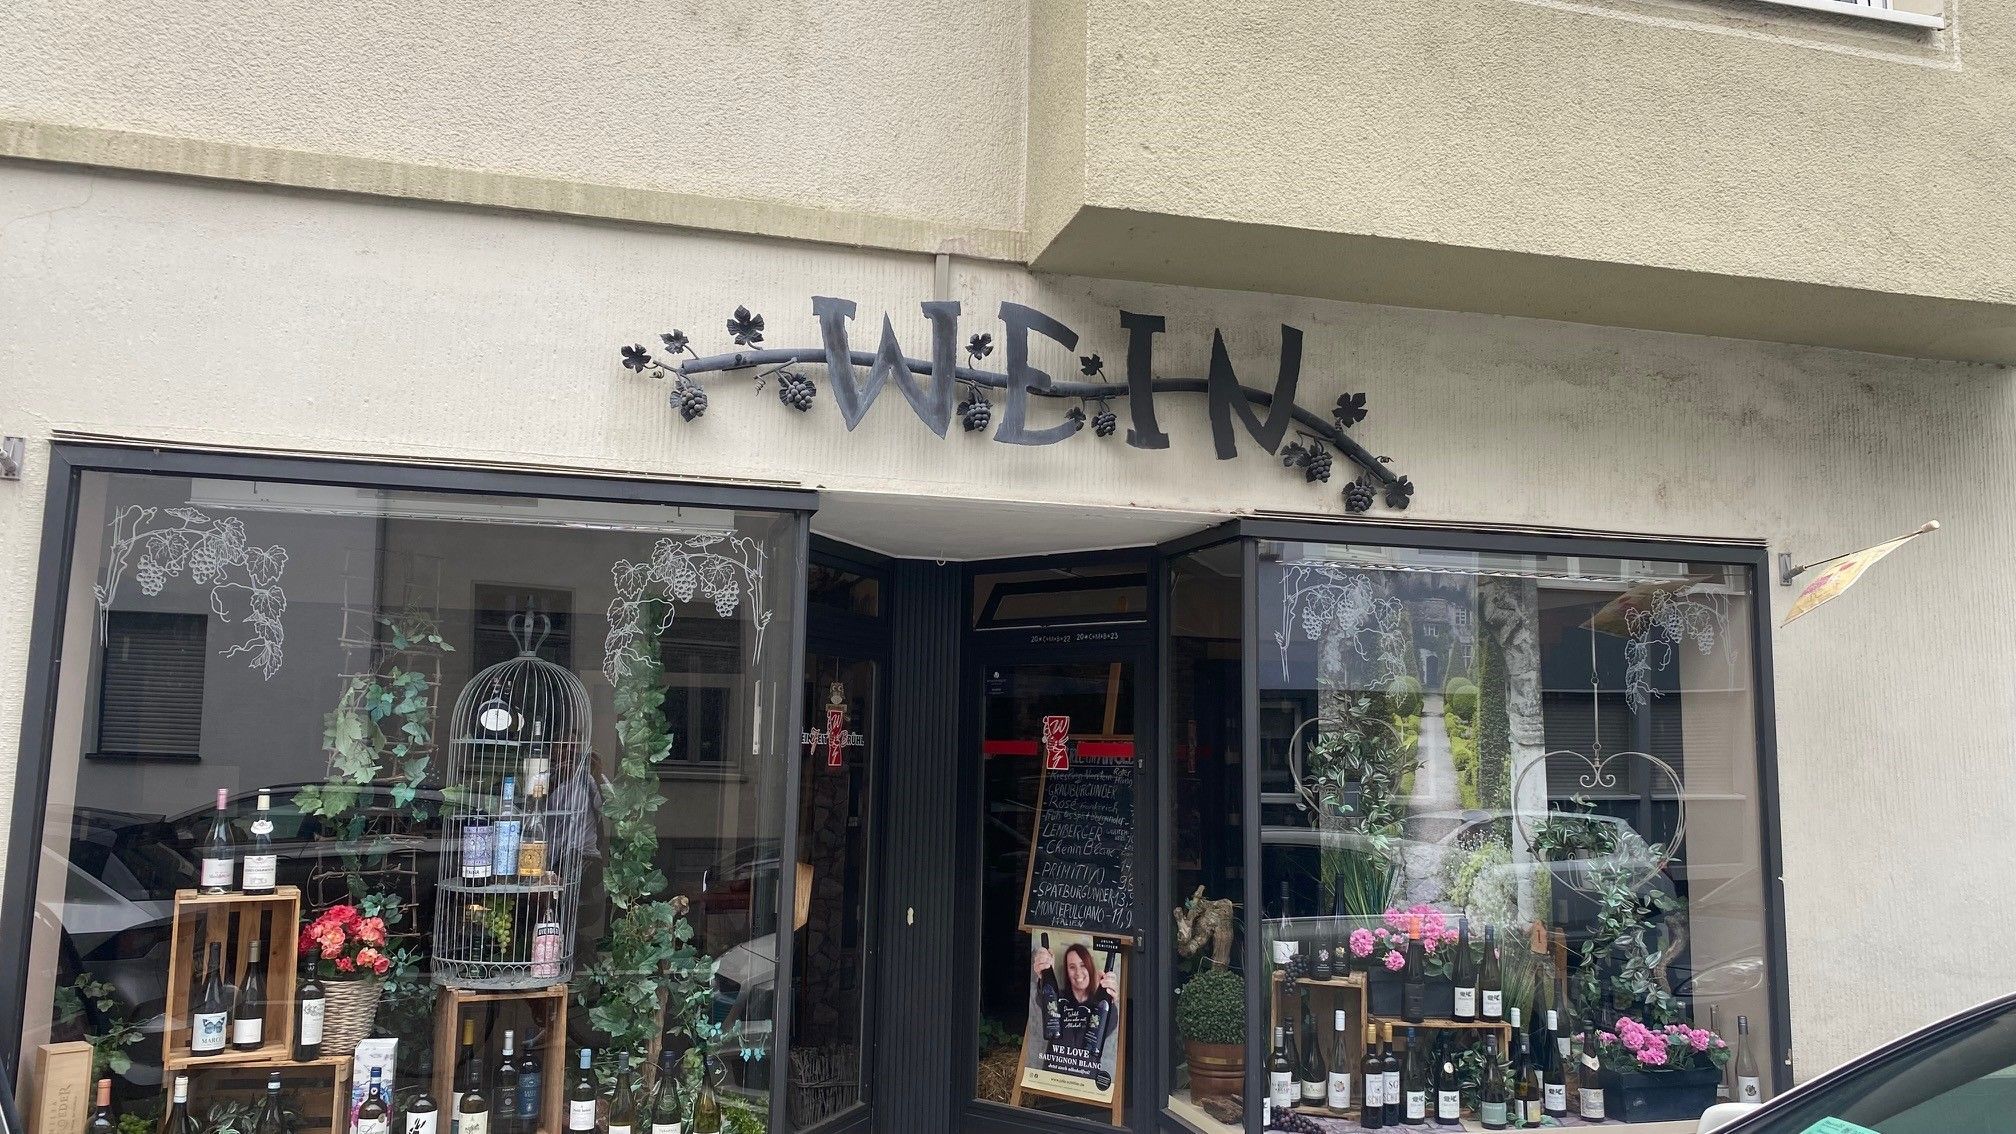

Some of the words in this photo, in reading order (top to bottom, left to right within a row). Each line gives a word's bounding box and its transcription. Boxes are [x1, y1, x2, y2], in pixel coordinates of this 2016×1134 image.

[812, 296, 1303, 460] WEIN
[1046, 839, 1081, 854] Chenin
[1052, 1044, 1065, 1054] WE
[1066, 1046, 1090, 1058] LOVE
[1038, 1052, 1078, 1066] SAUVIGNON
[1078, 1060, 1102, 1070] BLANC
